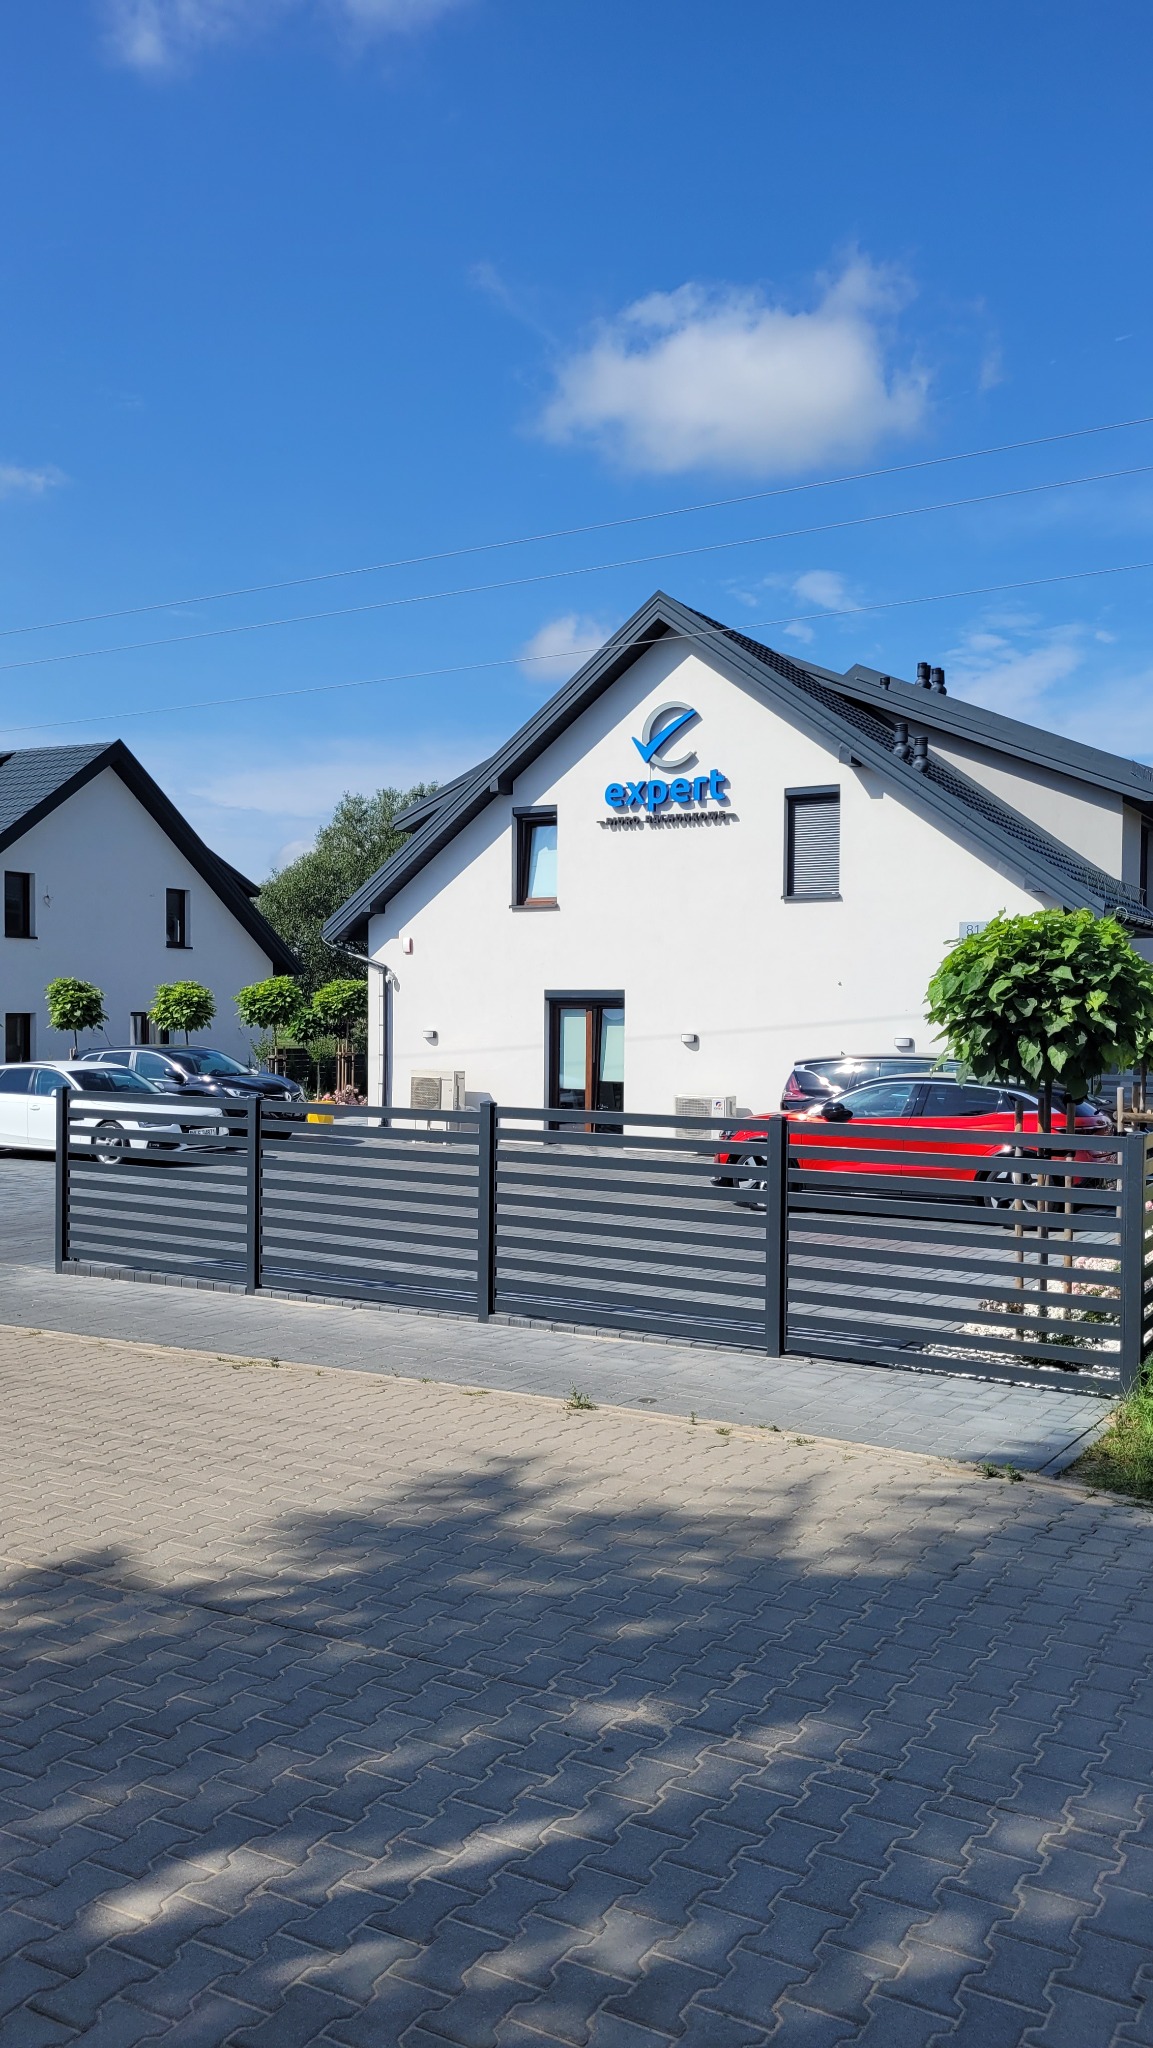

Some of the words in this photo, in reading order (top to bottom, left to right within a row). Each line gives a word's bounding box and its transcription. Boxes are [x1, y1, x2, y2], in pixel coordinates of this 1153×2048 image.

[605, 769, 726, 812] expert
[606, 816, 641, 826] BIURO
[966, 924, 979, 935] 81
